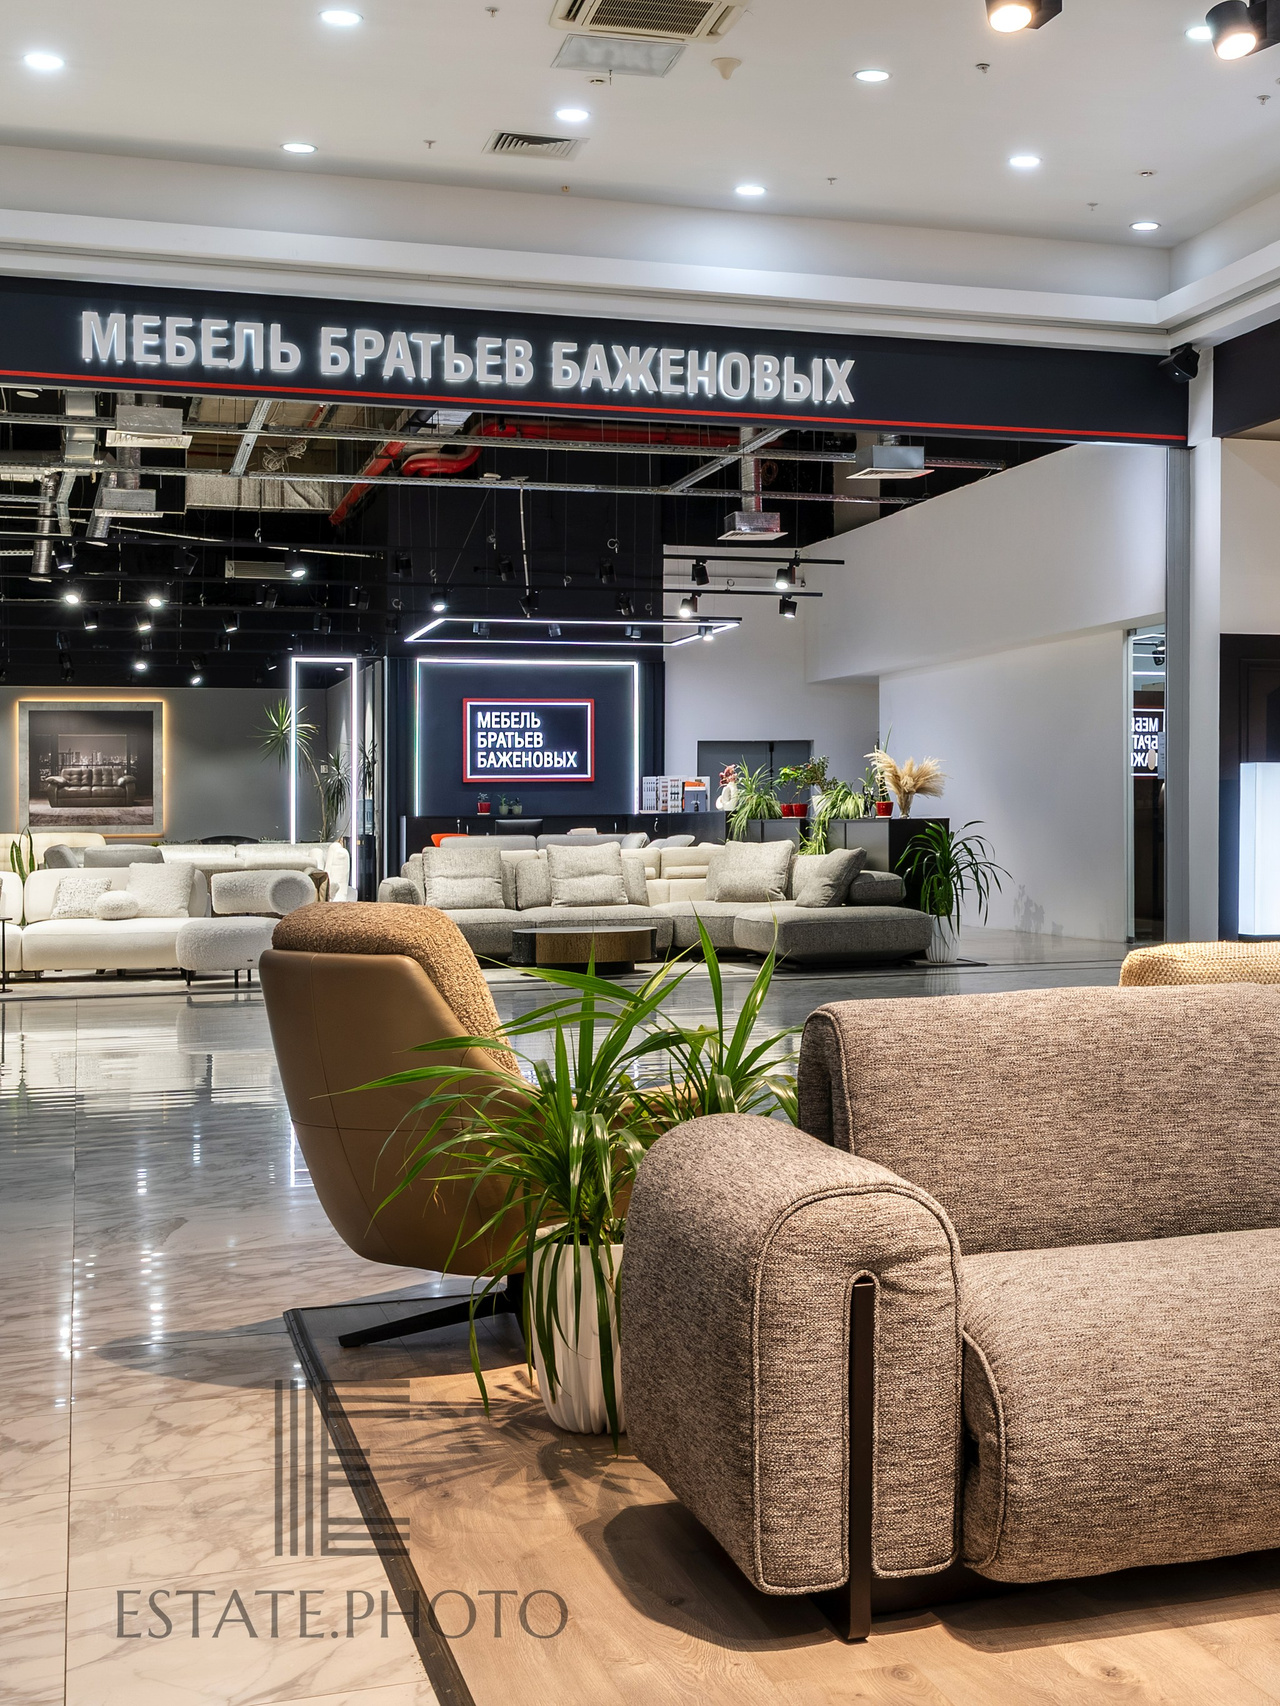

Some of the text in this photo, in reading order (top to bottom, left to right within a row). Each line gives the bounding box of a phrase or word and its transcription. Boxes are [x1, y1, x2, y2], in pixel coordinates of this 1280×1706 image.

[82, 310, 855, 404] МЕБЕЛЬ БРАТЬЕВ БАЖЕНОВЫХ
[477, 711, 541, 728] МЕБЕЛЬ
[477, 731, 543, 748] БРАТЬЕВ
[477, 751, 577, 768] БАЖЕНОВЫХ
